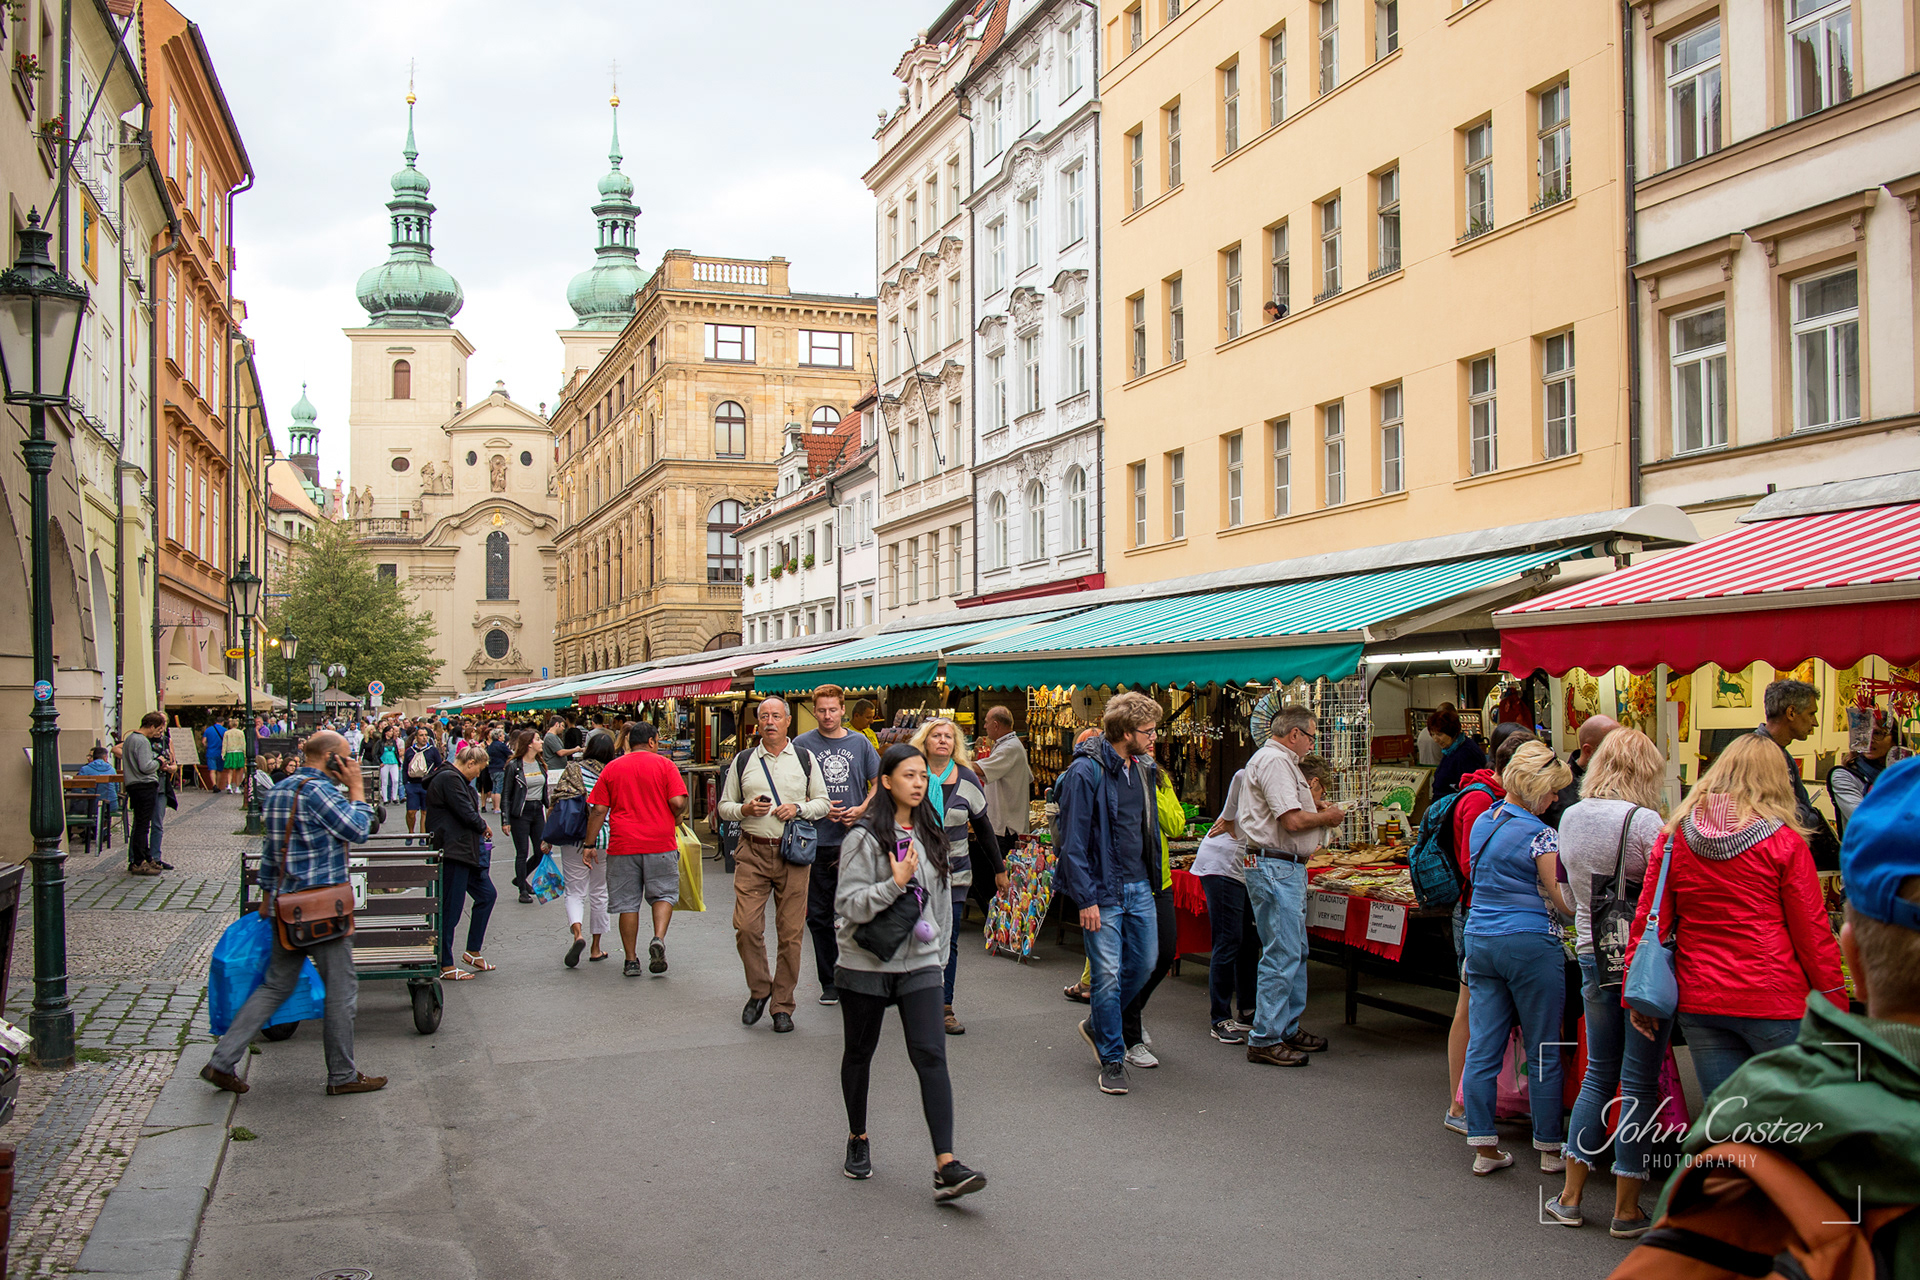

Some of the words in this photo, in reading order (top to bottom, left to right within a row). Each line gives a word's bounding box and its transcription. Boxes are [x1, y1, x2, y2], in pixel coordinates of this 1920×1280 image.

[816, 748, 832, 762] NEW
[836, 747, 855, 761] YORK
[827, 785, 849, 793] STATE
[1372, 902, 1394, 912] PAPRIKA
